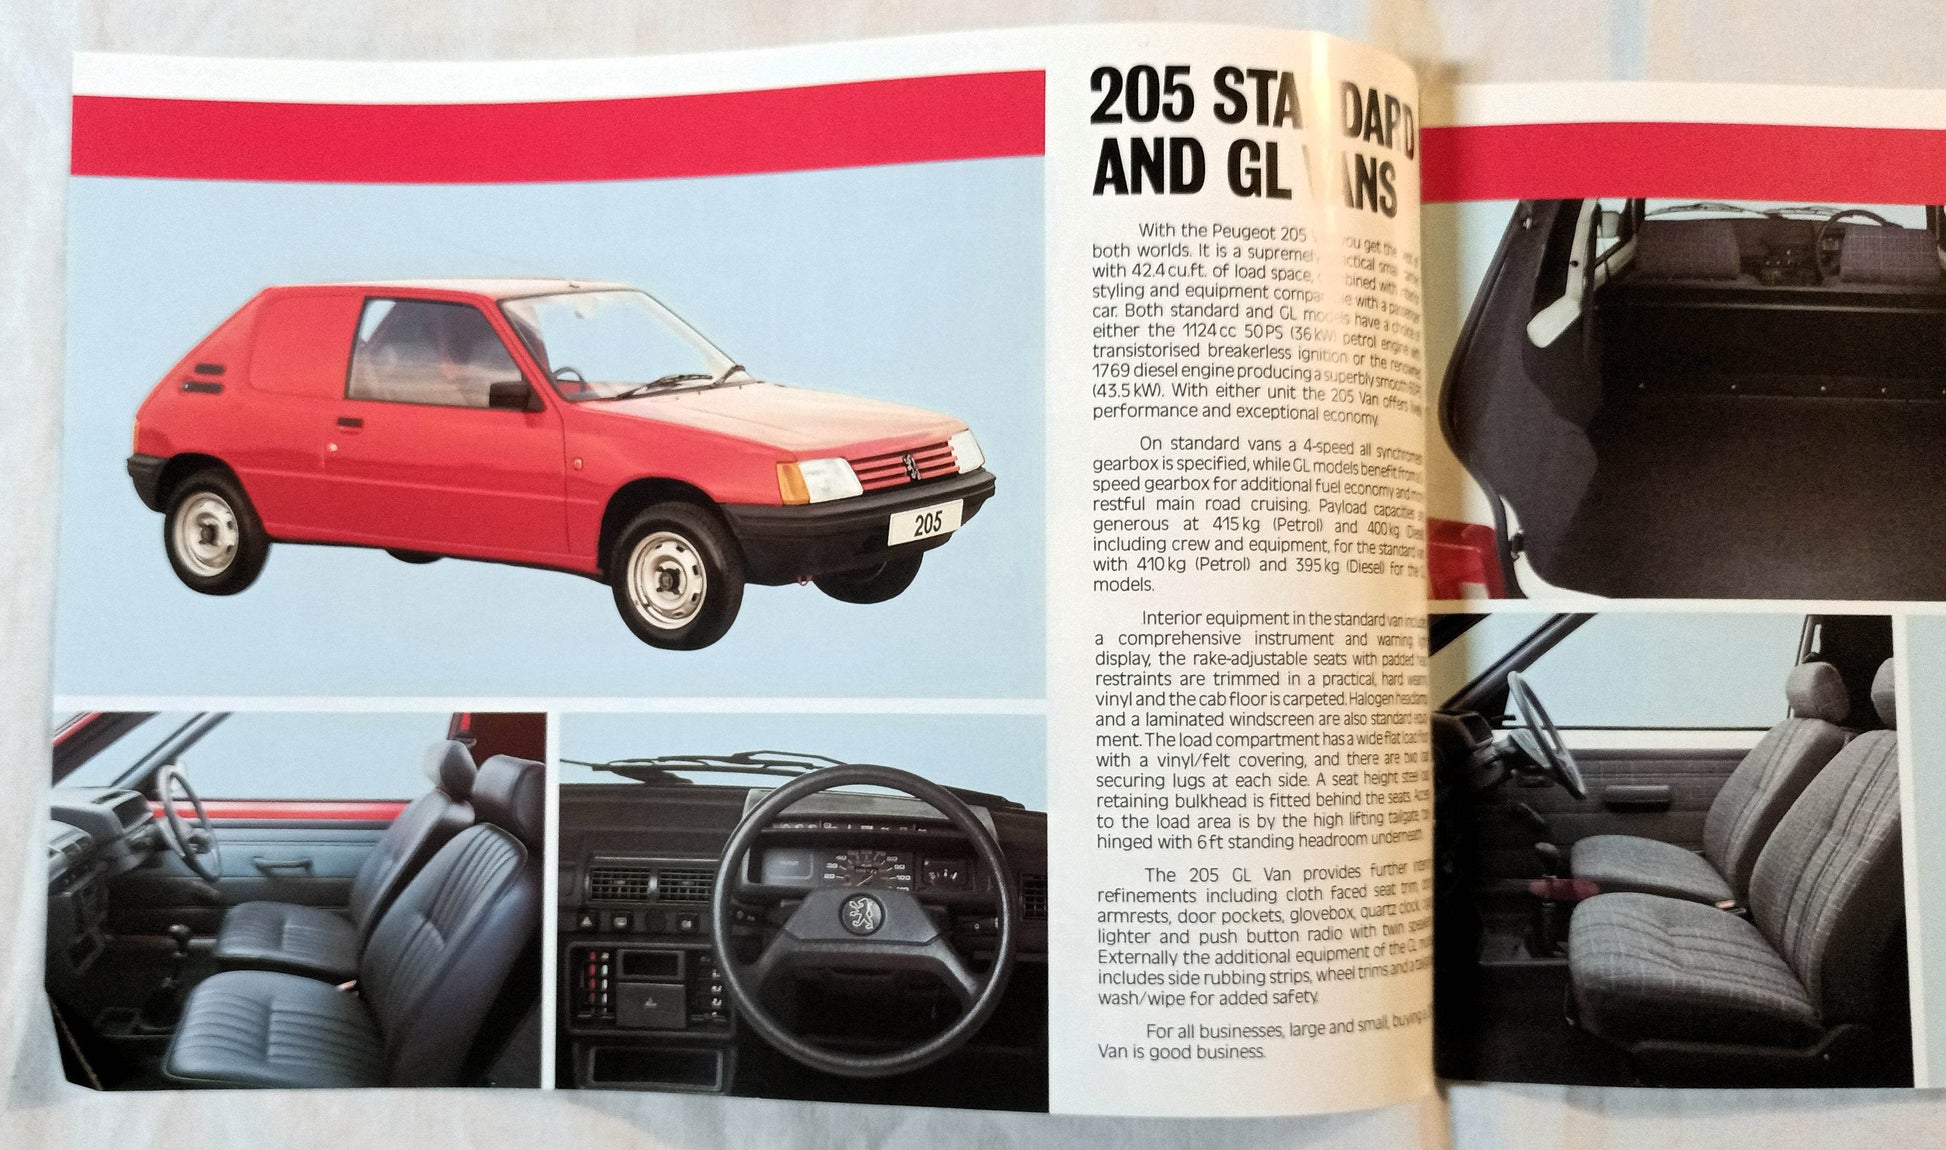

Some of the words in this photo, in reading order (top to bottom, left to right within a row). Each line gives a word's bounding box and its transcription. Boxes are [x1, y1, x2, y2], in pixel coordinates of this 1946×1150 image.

[1090, 65, 1195, 125] 205
[1093, 137, 1206, 196] AND
[1227, 139, 1293, 200] GL
[1139, 223, 1175, 237] With
[1182, 223, 1207, 237] the
[1213, 223, 1275, 241] Peugeot
[1281, 227, 1306, 242] 205
[1093, 243, 1130, 258] both
[1137, 243, 1191, 257] worlds.
[1199, 244, 1209, 257] It
[1217, 243, 1227, 257] is
[1093, 263, 1126, 277] with
[1213, 263, 1229, 278] of
[1235, 264, 1265, 279] load
[1271, 268, 1310, 282] space,
[1093, 283, 1144, 299] styling
[1150, 283, 1179, 297] and
[1186, 284, 1268, 300] equipment
[1093, 306, 1117, 318] car.
[1126, 303, 1163, 317] Both
[1171, 303, 1238, 317] standard
[1246, 305, 1273, 319] and
[1280, 306, 1297, 320] GL
[1093, 323, 1140, 338] either
[1148, 323, 1175, 337] the
[1093, 343, 1199, 358] transistorised
[1208, 343, 1291, 359] breakerless
[1092, 363, 1130, 377] 1769
[1134, 363, 1177, 377] diesel
[1180, 364, 1237, 384] engine
[1236, 365, 1311, 385] producing
[1172, 383, 1207, 397] With
[1216, 383, 1260, 398] either
[1268, 385, 1296, 399] unit
[1302, 386, 1325, 401] the
[1094, 403, 1198, 420] performance
[1203, 403, 1231, 417] and
[1237, 405, 1318, 420] exceptional
[1140, 436, 1161, 450] On
[1171, 436, 1239, 450] standard
[1248, 440, 1281, 451] vans
[1093, 456, 1158, 473] gearbox
[1163, 456, 1173, 470] is
[1177, 456, 1249, 472] specified,
[1253, 457, 1290, 472] while
[1293, 458, 1310, 472] GL
[1093, 476, 1140, 493] speed
[1145, 476, 1209, 493] gearbox
[1213, 476, 1237, 491] for
[1241, 476, 1311, 492] additional
[1094, 496, 1144, 511] restful
[1157, 496, 1194, 510] main
[1206, 497, 1240, 511] road
[1251, 497, 1310, 514] cruising.
[914, 510, 942, 537] 205
[1094, 519, 1168, 533] generous
[1184, 517, 1199, 531] at
[1273, 517, 1323, 532] (Petrol)
[1094, 536, 1166, 553] including
[1172, 539, 1210, 551] crew
[1215, 537, 1243, 551] and
[1093, 557, 1127, 571] with
[1196, 557, 1250, 571] (Petrol)
[1260, 557, 1286, 571] and
[1094, 577, 1154, 591] models.
[1143, 610, 1202, 625] Interior
[1206, 610, 1289, 627] equipment
[1293, 611, 1305, 625] in
[1119, 631, 1241, 647] comprehensive
[1096, 651, 1151, 668] display,
[1159, 651, 1185, 665] the
[1194, 651, 1307, 667] rake-adjustable
[1096, 671, 1171, 686] restraints
[1180, 674, 1205, 686] are
[1213, 671, 1279, 686] trimmed
[1288, 671, 1300, 685] in
[1096, 691, 1132, 708] vinyl
[1136, 692, 1165, 706] and
[1169, 692, 1196, 706] the
[1199, 691, 1226, 706] cab
[1229, 691, 1267, 706] floor
[1270, 691, 1280, 706] is
[1096, 712, 1125, 726] and
[1146, 712, 1224, 726] laminated
[1229, 712, 1314, 726] windscreen
[1097, 733, 1142, 747] ment.
[1145, 732, 1175, 747] The
[1180, 732, 1212, 747] load
[1216, 733, 1320, 749] compartment
[1096, 752, 1130, 767] with
[1157, 753, 1230, 769] vinyl/felt
[1239, 752, 1307, 769] covering,
[1097, 773, 1165, 790] securing
[1173, 773, 1205, 790] lugs
[1213, 774, 1228, 787] at
[1236, 773, 1271, 787] each
[1279, 772, 1309, 787] side.
[1097, 793, 1168, 810] retaining
[1176, 793, 1246, 808] bulkhead
[1254, 793, 1264, 808] is
[1269, 793, 1310, 807] fitted
[1097, 814, 1114, 828] to
[1122, 814, 1149, 828] the
[1157, 814, 1189, 829] load
[1198, 817, 1231, 829] area
[1239, 814, 1249, 828] is
[1257, 814, 1275, 830] by
[1283, 813, 1307, 828] the
[1098, 834, 1152, 851] hinged
[1158, 834, 1192, 849] with
[1228, 834, 1294, 850] standing
[1145, 867, 1176, 882] The
[1190, 868, 1219, 882] 205
[1233, 868, 1251, 882] GL
[1264, 867, 1291, 881] Van
[1098, 888, 1196, 903] refinements
[1207, 888, 1277, 904] including
[1286, 886, 1323, 901] cloth
[1098, 910, 1171, 925] armrests,
[1178, 909, 1216, 923] door
[1222, 908, 1284, 925] pockets,
[1099, 929, 1151, 945] lighter
[1160, 929, 1189, 944] and
[1200, 929, 1237, 946] push
[1247, 929, 1299, 943] button
[1099, 949, 1178, 966] Externally
[1183, 950, 1210, 965] the
[1215, 949, 1290, 964] additional
[1099, 969, 1164, 985] includes
[1168, 970, 1200, 985] side
[1204, 970, 1265, 986] rubbing
[1098, 991, 1185, 1008] wash/wipe
[1190, 991, 1215, 1006] for
[1220, 991, 1268, 1005] added
[1147, 1024, 1174, 1038] For
[1178, 1024, 1194, 1038] all
[1098, 1044, 1127, 1058] Van
[1134, 1044, 1144, 1058] is
[1150, 1045, 1191, 1061] good
